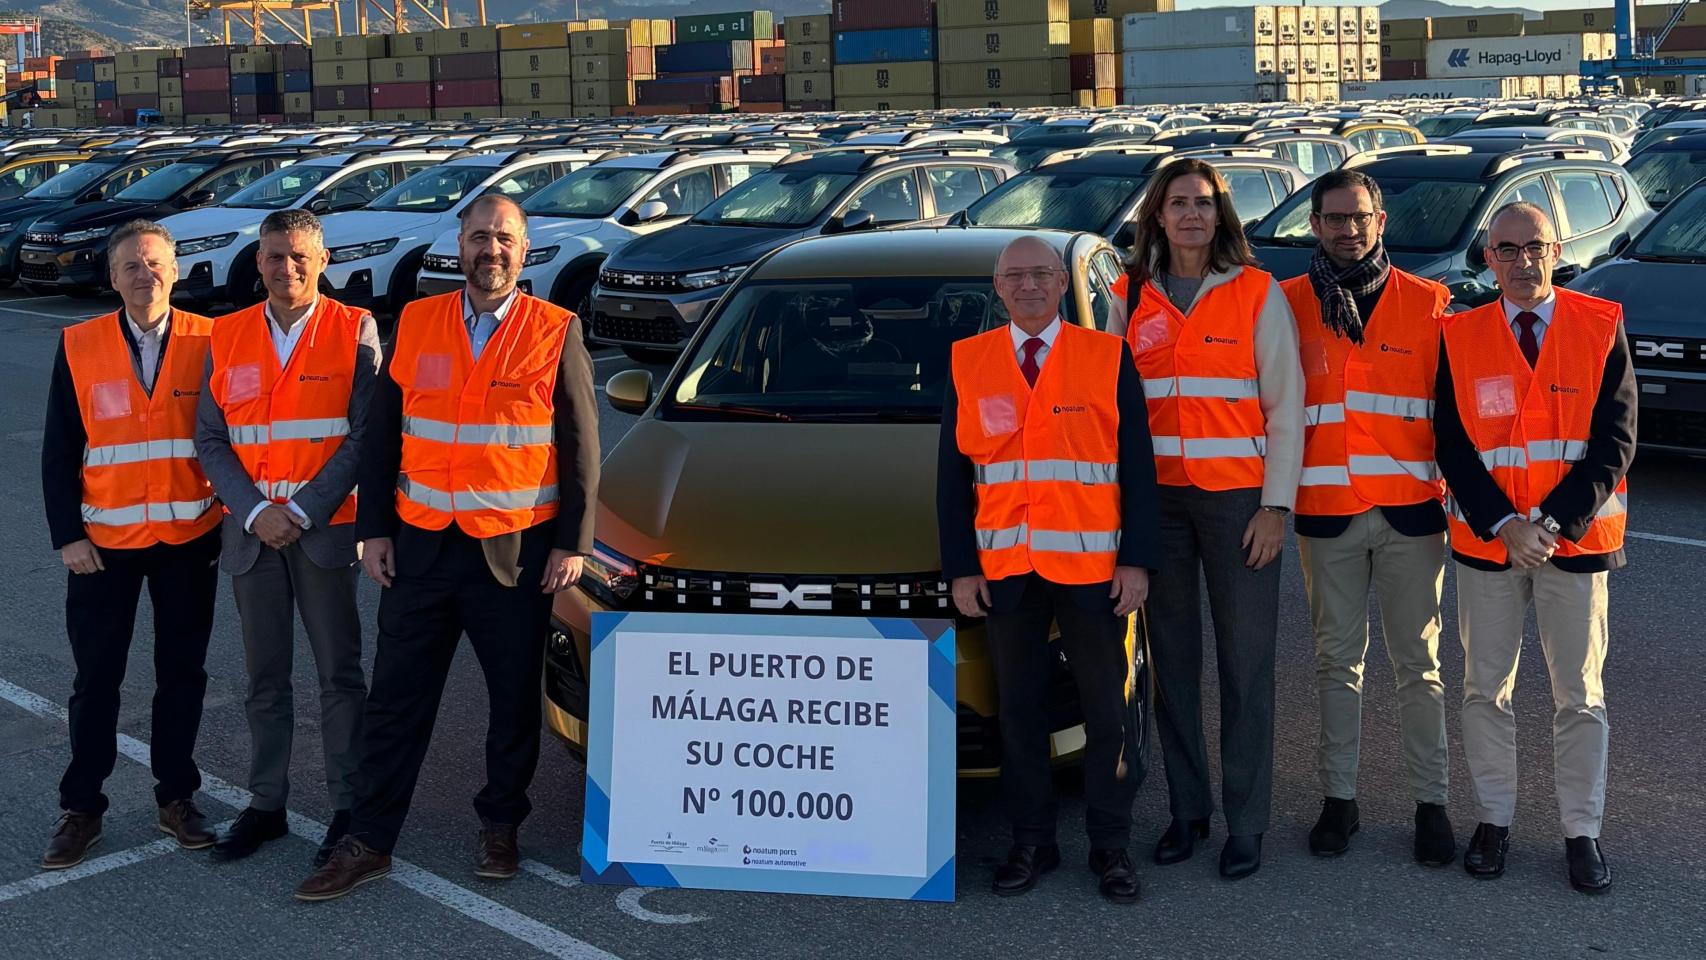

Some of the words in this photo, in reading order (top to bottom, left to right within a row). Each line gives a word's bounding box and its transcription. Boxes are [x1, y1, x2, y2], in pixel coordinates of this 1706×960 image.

[1478, 48, 1562, 66] Hapag-Lloyd
[668, 651, 699, 676] EL
[709, 653, 825, 679] PUERTO
[836, 656, 873, 681] DE
[651, 689, 778, 723] MÁLAGA
[787, 700, 889, 727] RECIBE
[686, 741, 723, 767] SU
[733, 742, 835, 770] COCHE
[731, 789, 853, 820] 100.000
[752, 847, 778, 855] noatum
[780, 849, 797, 857] ports
